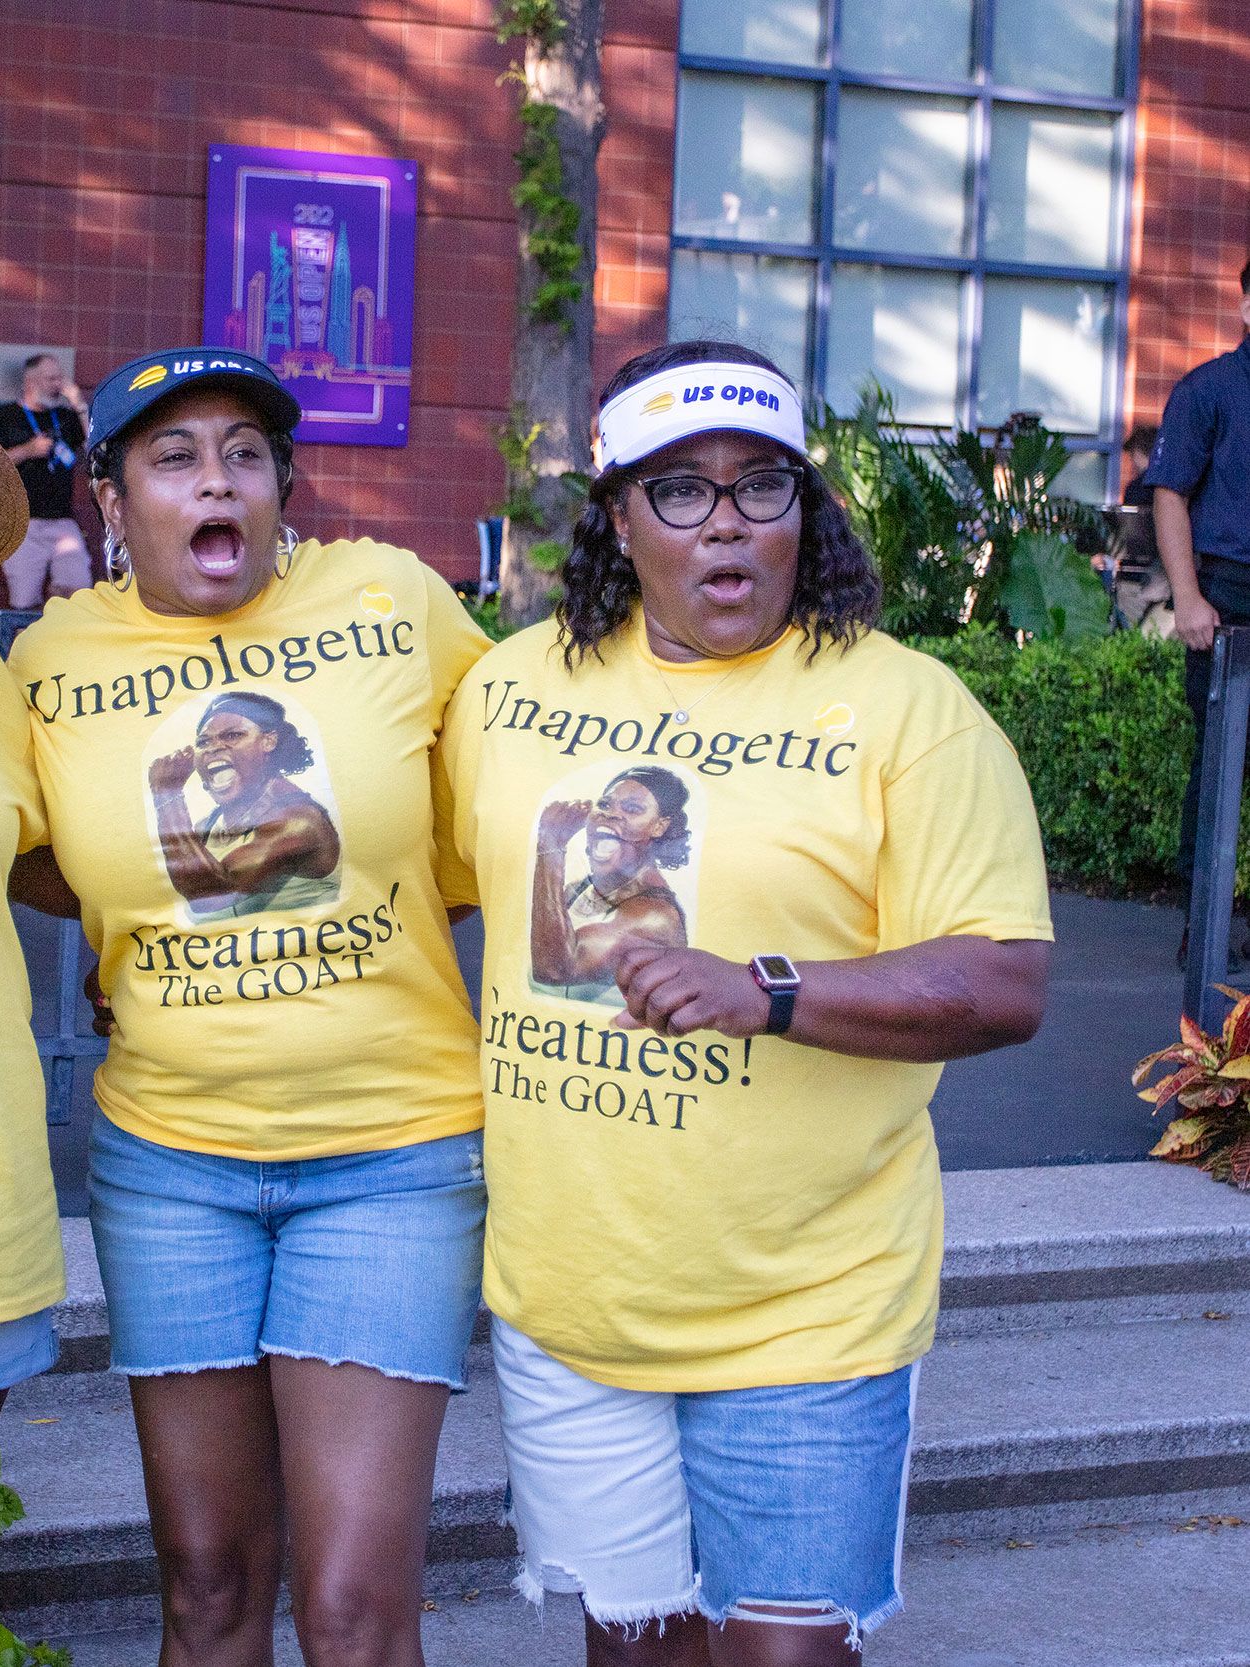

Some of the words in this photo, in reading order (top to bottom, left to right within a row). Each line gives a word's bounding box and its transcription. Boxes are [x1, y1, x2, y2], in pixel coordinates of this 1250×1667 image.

[295, 227, 333, 301] OPEN
[298, 304, 324, 343] US
[173, 360, 204, 374] us
[682, 385, 715, 403] us
[720, 384, 780, 411] open
[26, 620, 415, 724] Unapologetic
[482, 680, 857, 777] Unapologetic
[158, 975, 224, 1007] The
[237, 951, 374, 1001] GOAT
[490, 1057, 548, 1104] The
[560, 1075, 698, 1131] GOAT
